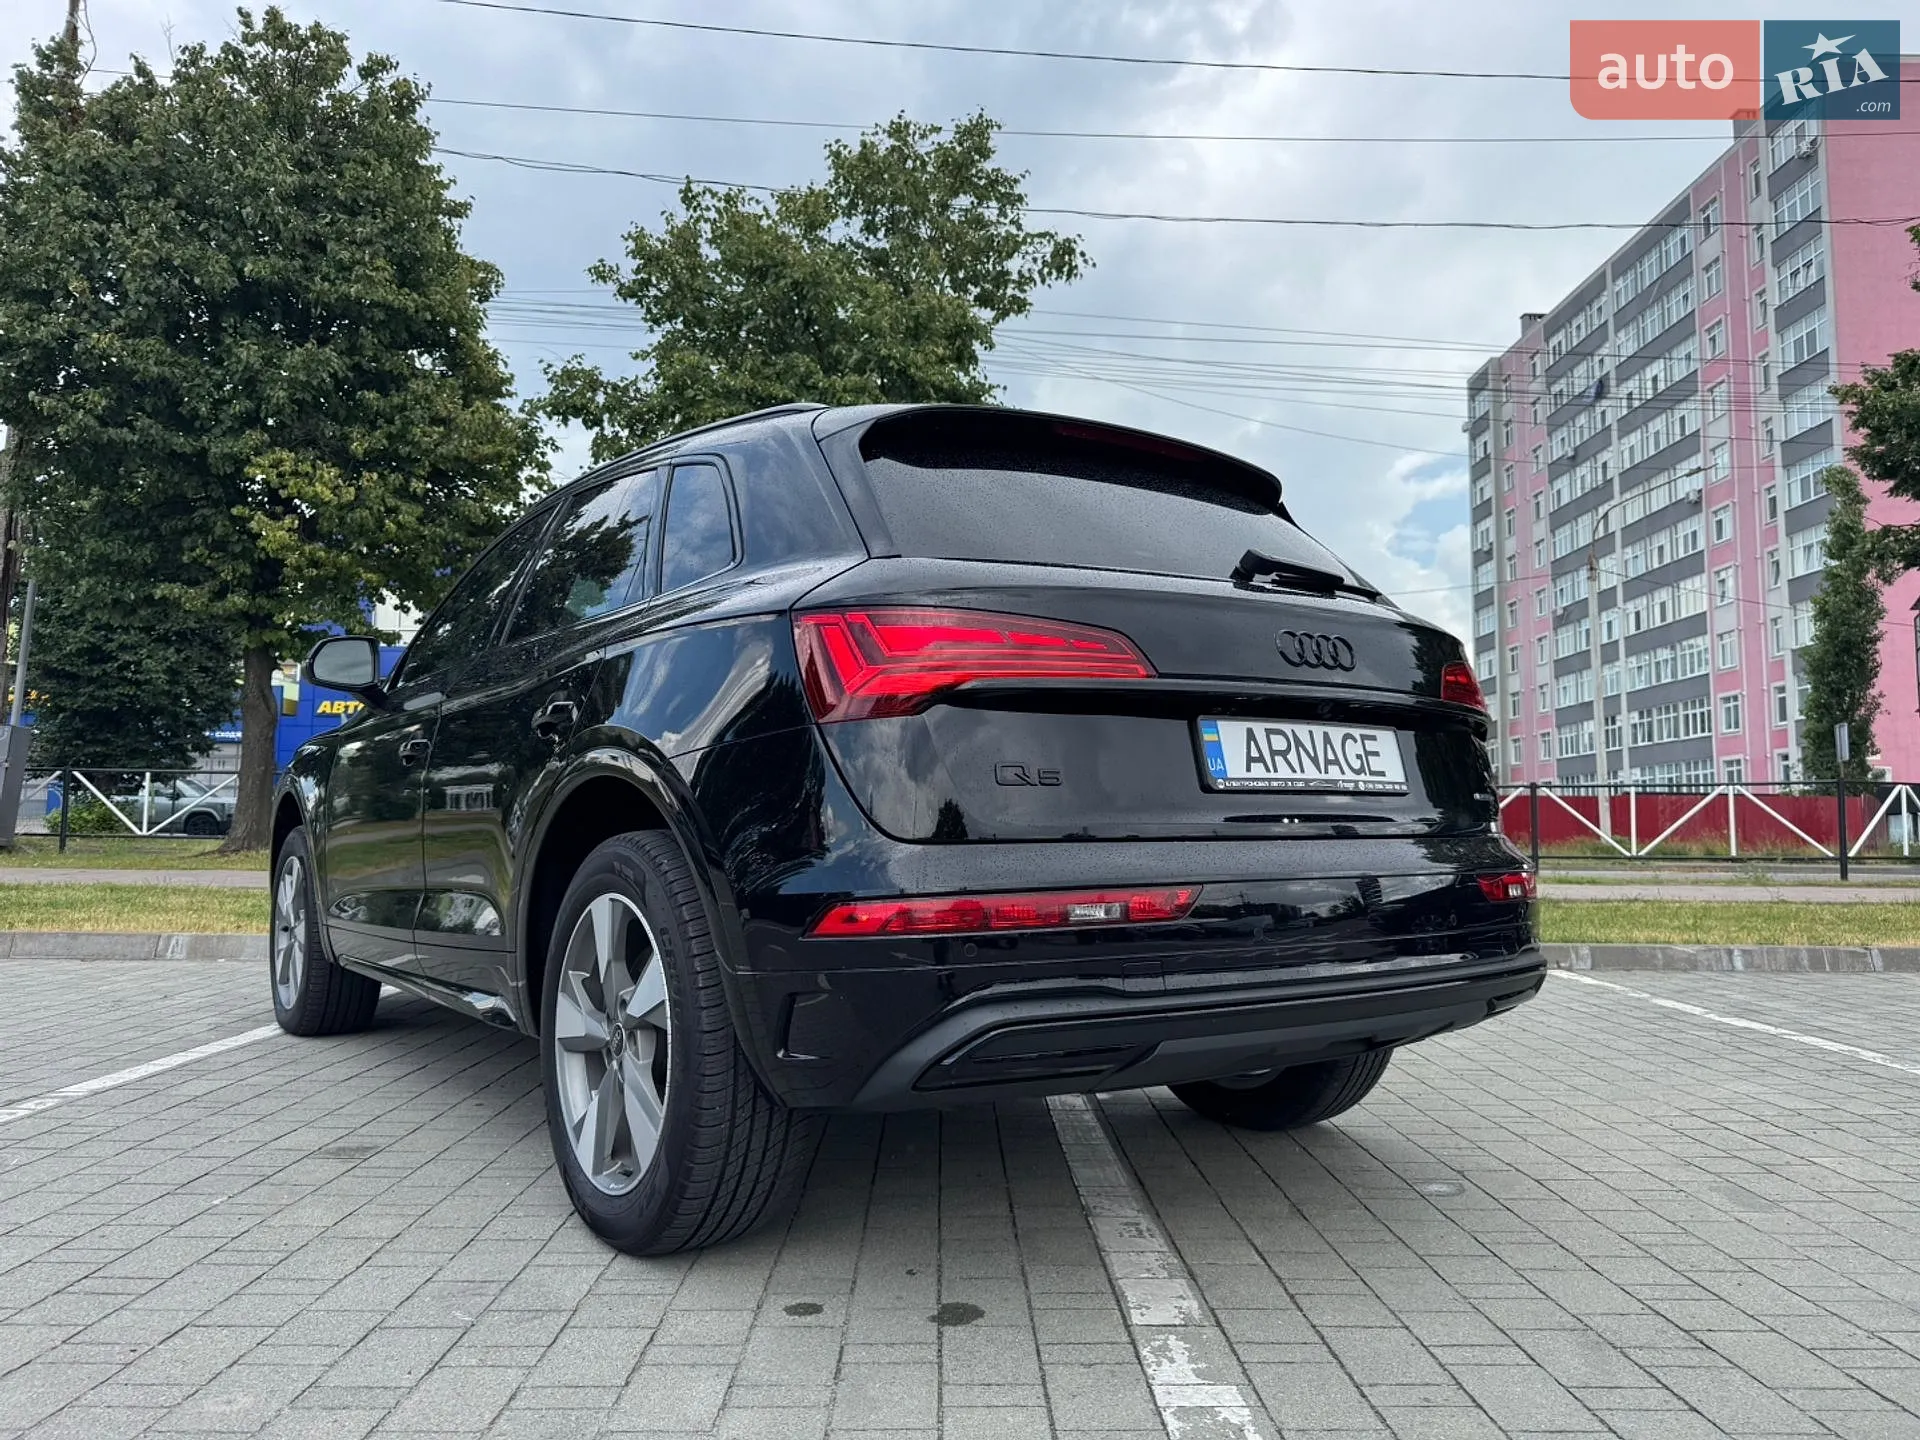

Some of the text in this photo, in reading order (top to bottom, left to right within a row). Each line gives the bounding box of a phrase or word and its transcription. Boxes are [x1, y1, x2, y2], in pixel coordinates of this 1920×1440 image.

[1208, 757, 1225, 772] UA
[1244, 726, 1387, 778] ARNAGE
[994, 762, 1062, 787] Q5
